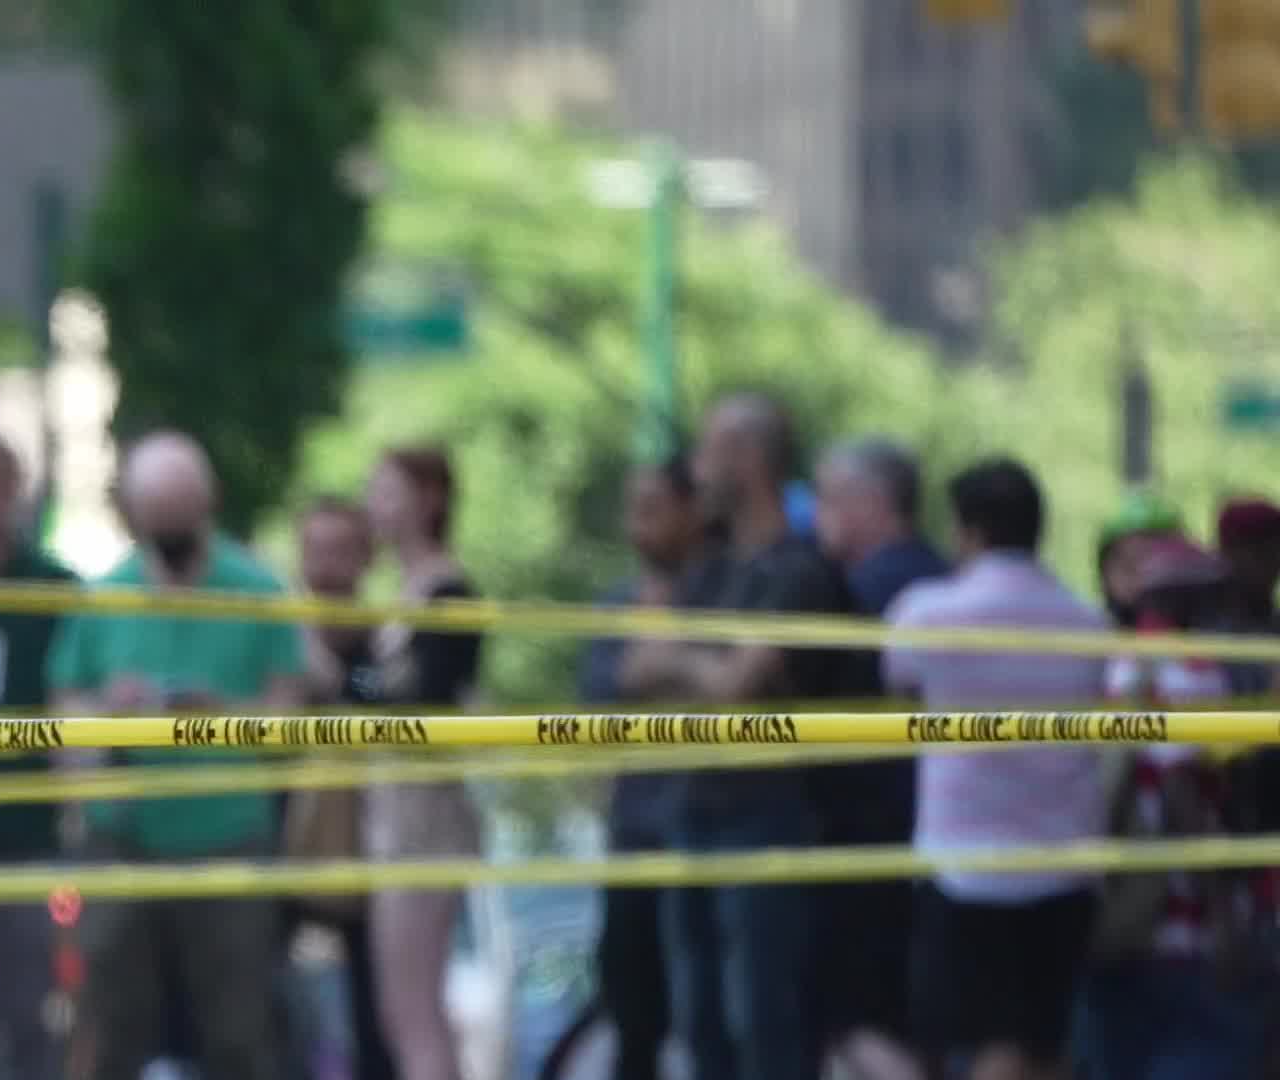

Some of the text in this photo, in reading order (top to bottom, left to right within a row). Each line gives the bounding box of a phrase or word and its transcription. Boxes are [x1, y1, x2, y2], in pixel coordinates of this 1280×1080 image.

[173, 719, 215, 745] FIRE
[281, 719, 308, 744] DO
[315, 719, 352, 744] NOT
[360, 719, 429, 744] CROSS
[538, 717, 580, 744] FIRE
[647, 717, 675, 743] DO
[682, 717, 720, 743] NOT
[728, 716, 797, 743] CROSS
[907, 716, 954, 742] FIRE
[1018, 715, 1045, 741] DO
[1052, 715, 1090, 742] NOT
[1098, 715, 1168, 742] CROSS
